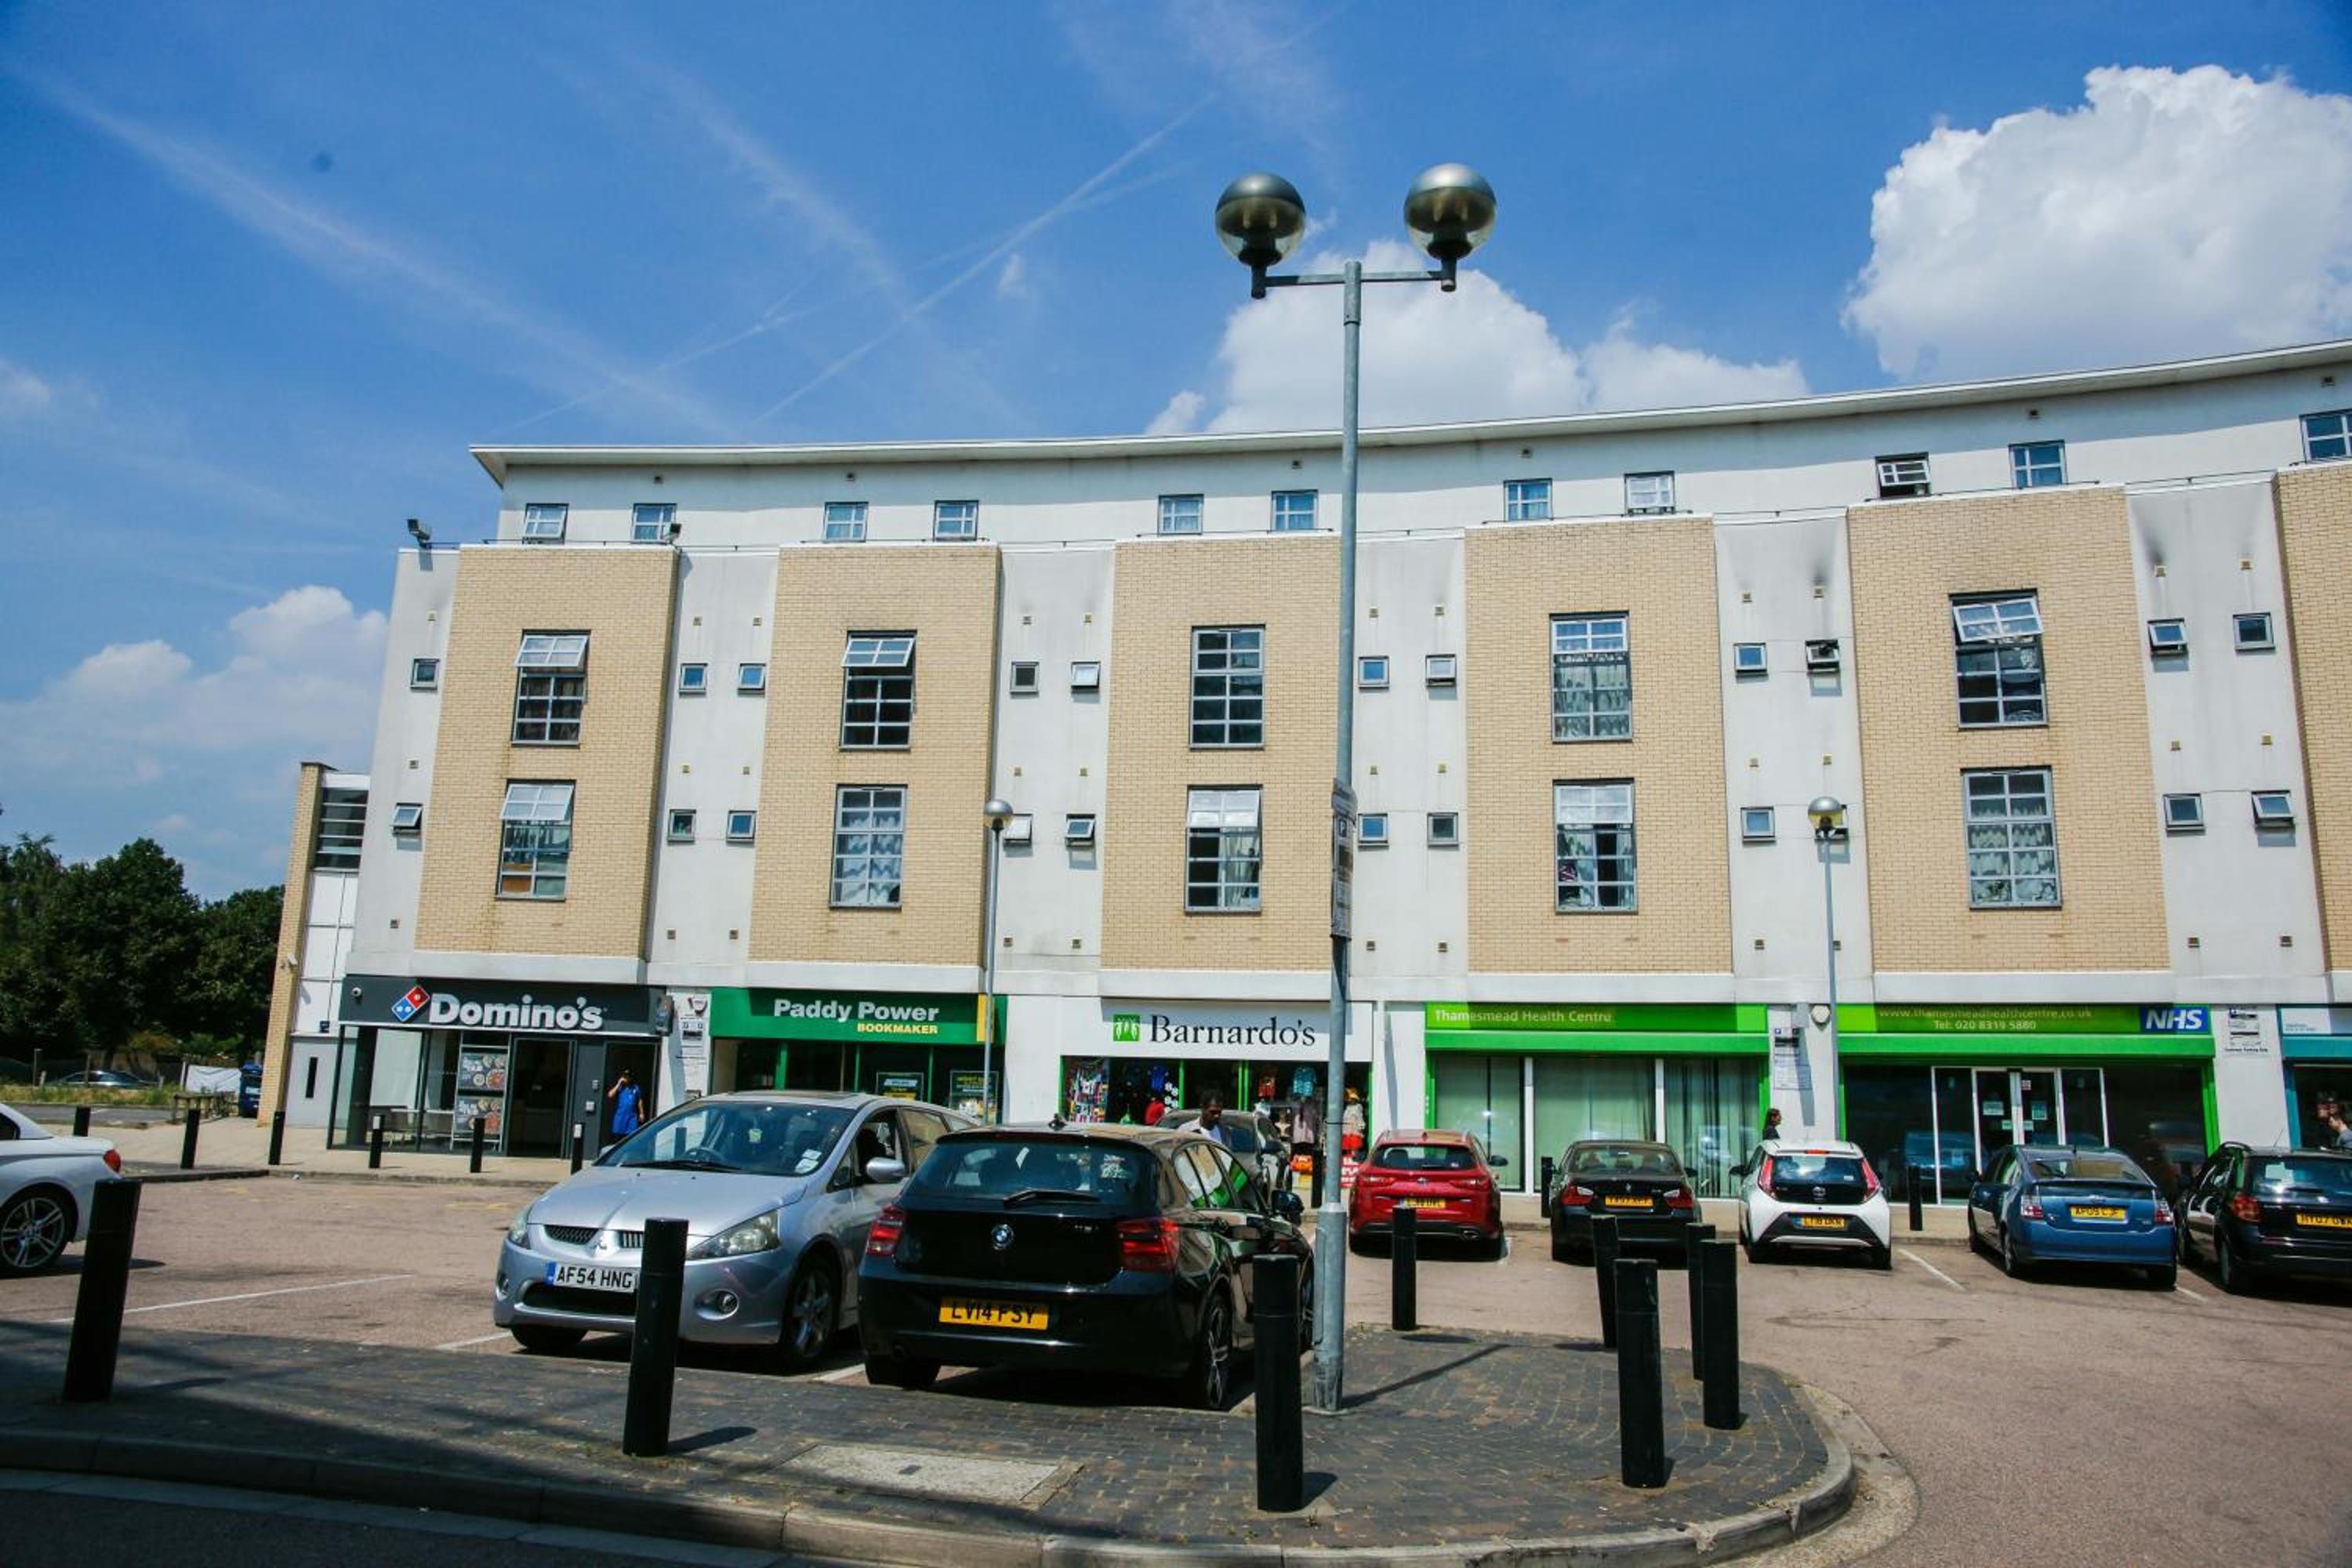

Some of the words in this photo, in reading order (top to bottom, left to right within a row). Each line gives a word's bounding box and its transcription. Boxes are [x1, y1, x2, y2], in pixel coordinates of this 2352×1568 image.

[429, 993, 604, 1030] Domino's
[773, 998, 852, 1023] Paddy
[858, 1001, 940, 1022] Power
[1435, 1009, 1519, 1022] Thamesmead
[1523, 1011, 1565, 1022] Health
[1569, 1011, 1613, 1023] Centre
[2145, 1009, 2203, 1030] NHS
[856, 1022, 939, 1034] BOOKMAKER
[1149, 1014, 1316, 1047] Barnardo's
[1955, 1020, 1976, 1029] 020
[556, 1266, 597, 1285] AF54
[601, 1269, 633, 1288] HNG
